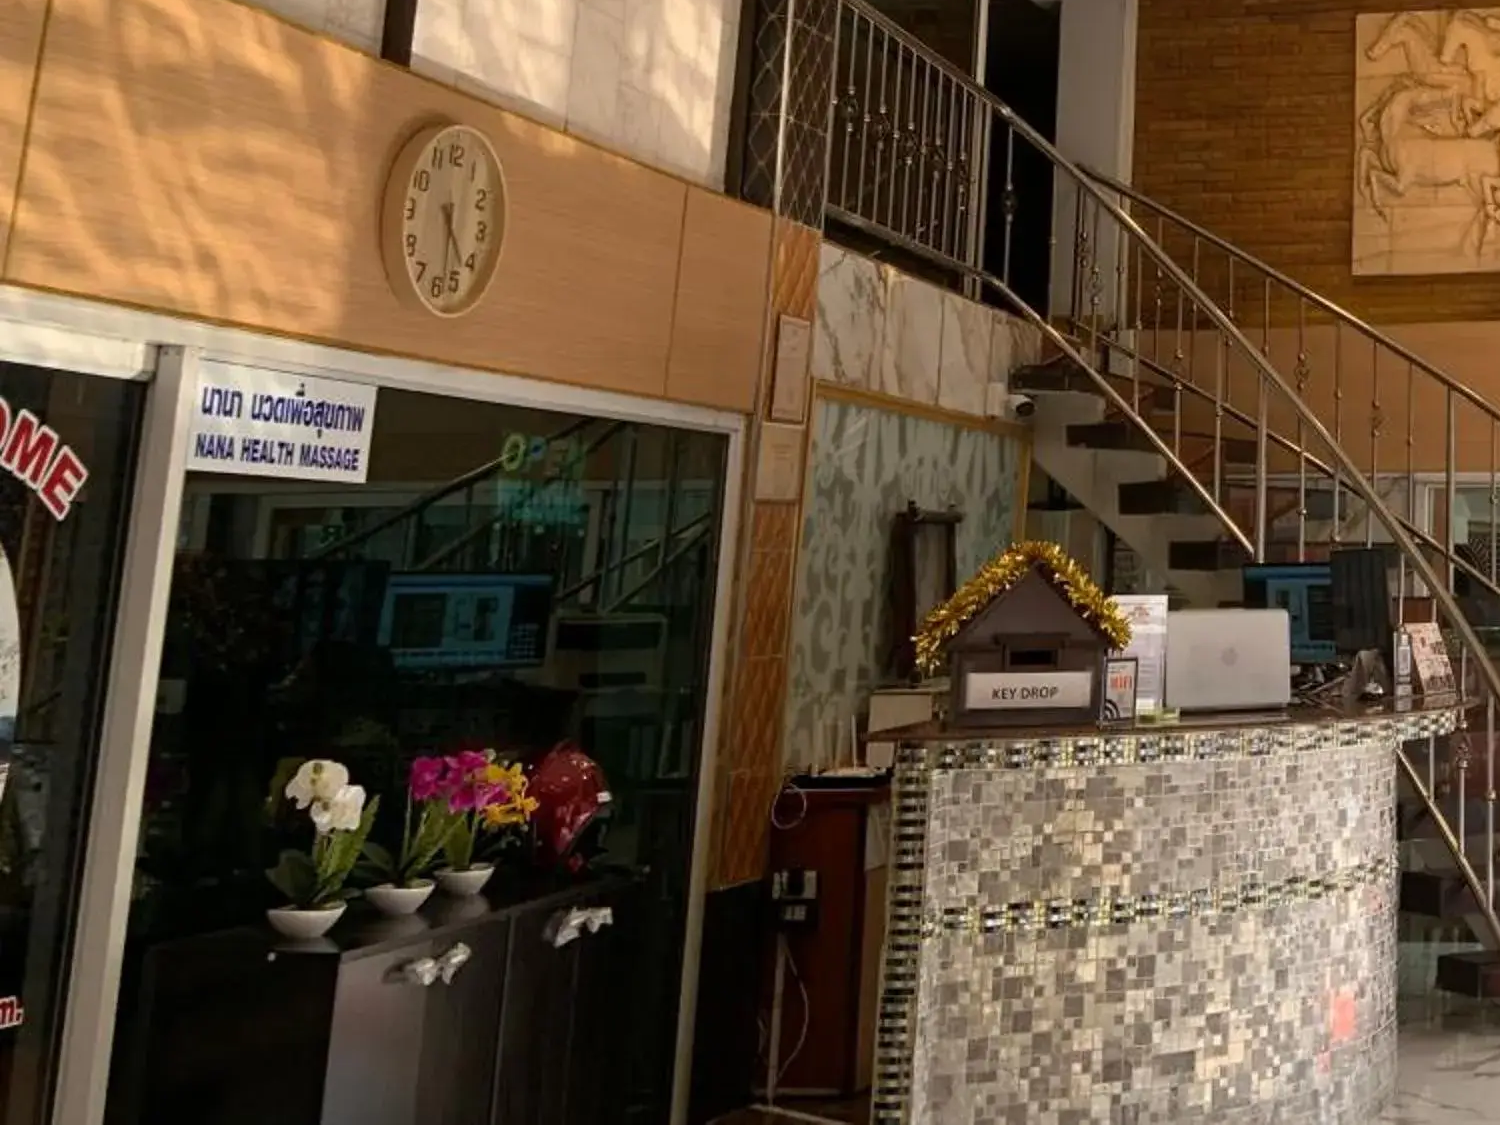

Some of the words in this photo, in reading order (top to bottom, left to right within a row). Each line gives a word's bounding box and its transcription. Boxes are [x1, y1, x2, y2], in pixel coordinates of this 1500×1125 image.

[432, 146, 444, 170] 11
[449, 144, 465, 168] 12
[413, 170, 430, 192] 10
[404, 197, 415, 220] 9
[475, 189, 487, 211] 2
[475, 221, 487, 242] 3
[405, 234, 417, 257] 8
[415, 261, 427, 283] 7
[464, 253, 476, 271] 4
[431, 277, 443, 298] 6
[448, 270, 460, 293] 5
[202, 386, 243, 418] นานา
[195, 433, 235, 460] NANA
[240, 437, 295, 465] HEALTH
[299, 442, 361, 472] MASSAGE
[992, 687, 1017, 700] KEY
[1021, 686, 1059, 700] DROP
